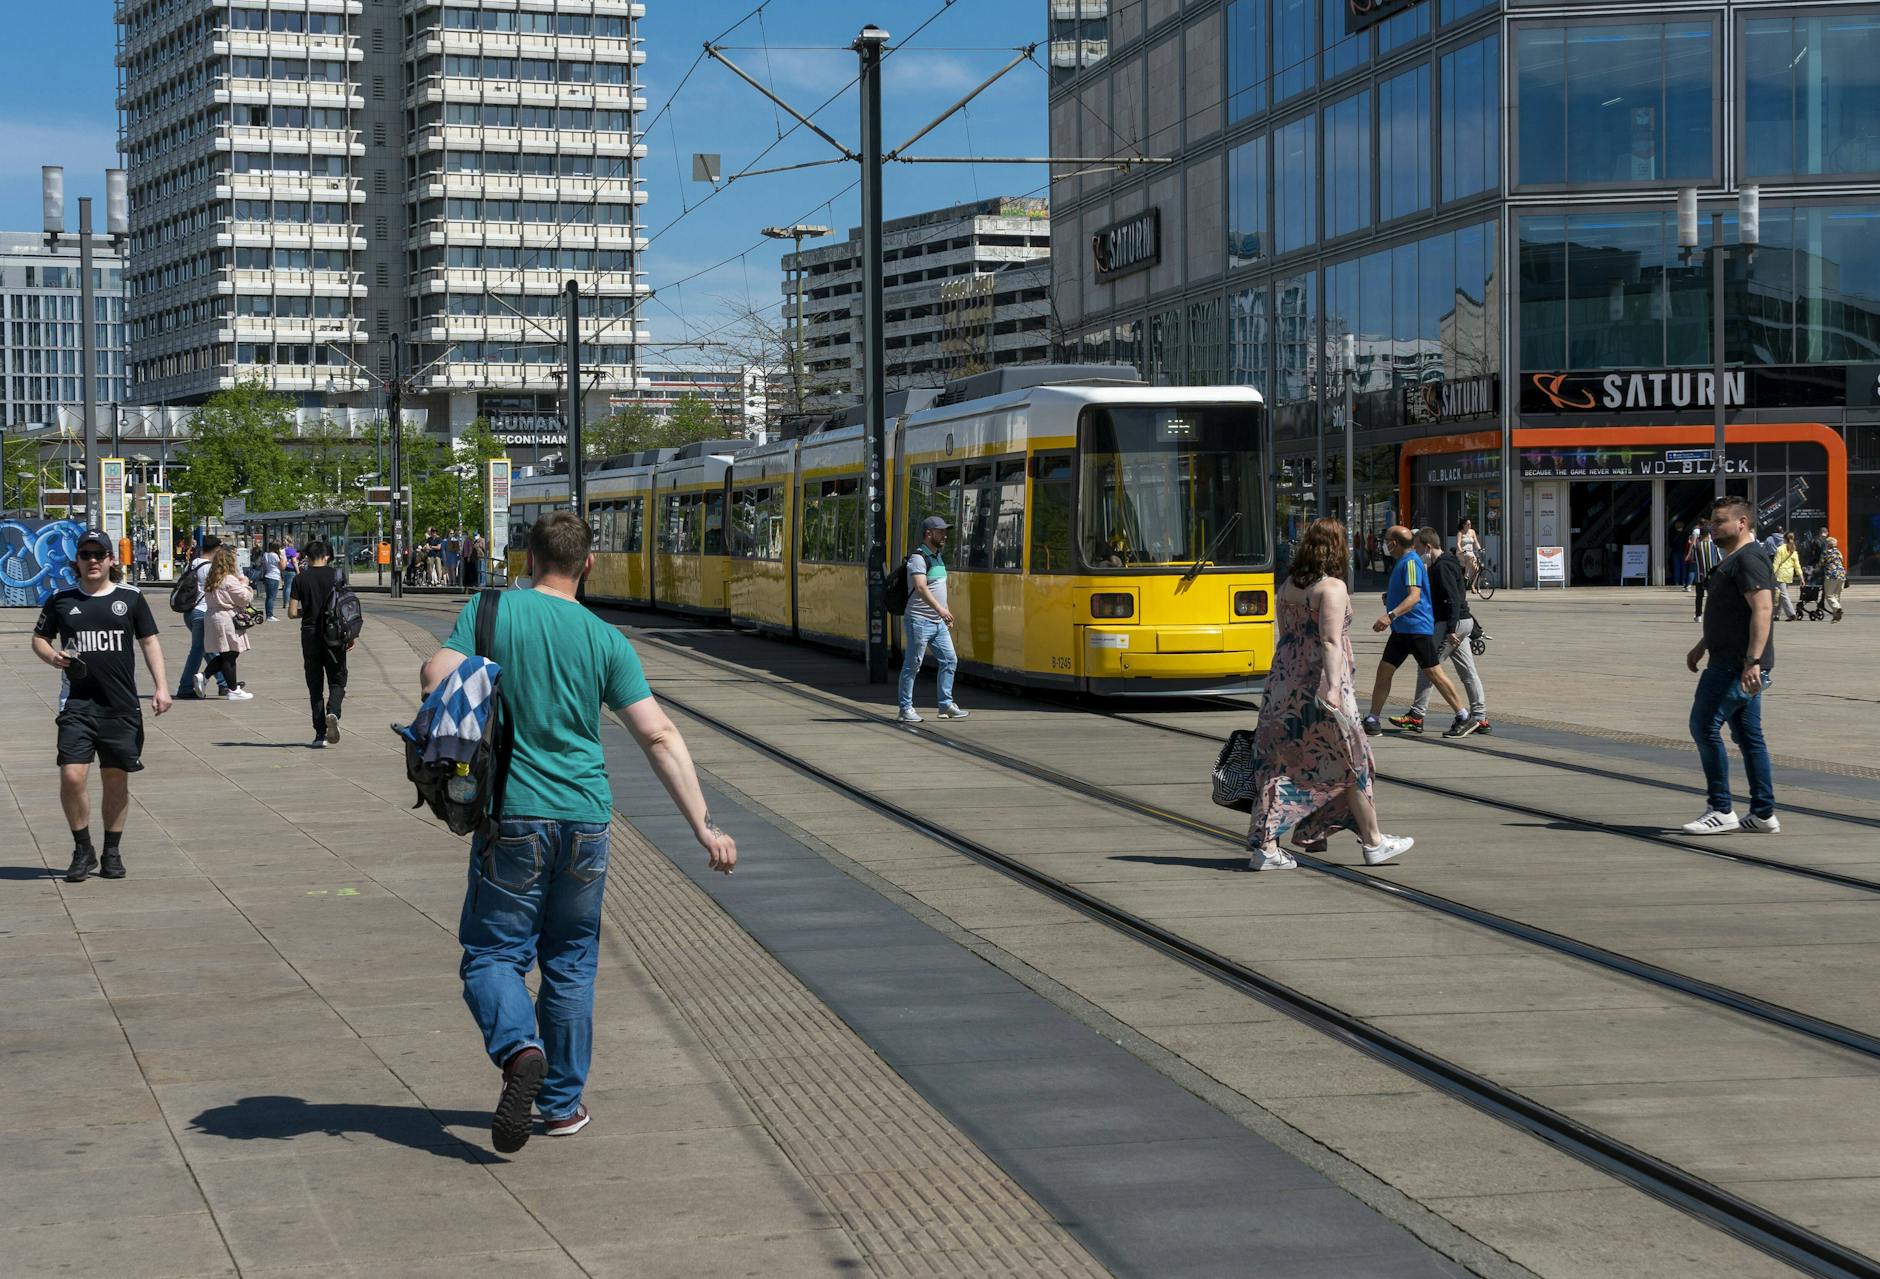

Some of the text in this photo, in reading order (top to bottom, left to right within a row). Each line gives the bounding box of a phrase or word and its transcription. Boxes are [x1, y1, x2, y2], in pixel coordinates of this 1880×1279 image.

[1110, 217, 1150, 270] SATURN
[1442, 379, 1488, 416] SATURN
[1603, 371, 1745, 409] SATURN
[489, 416, 560, 430] HUMAN
